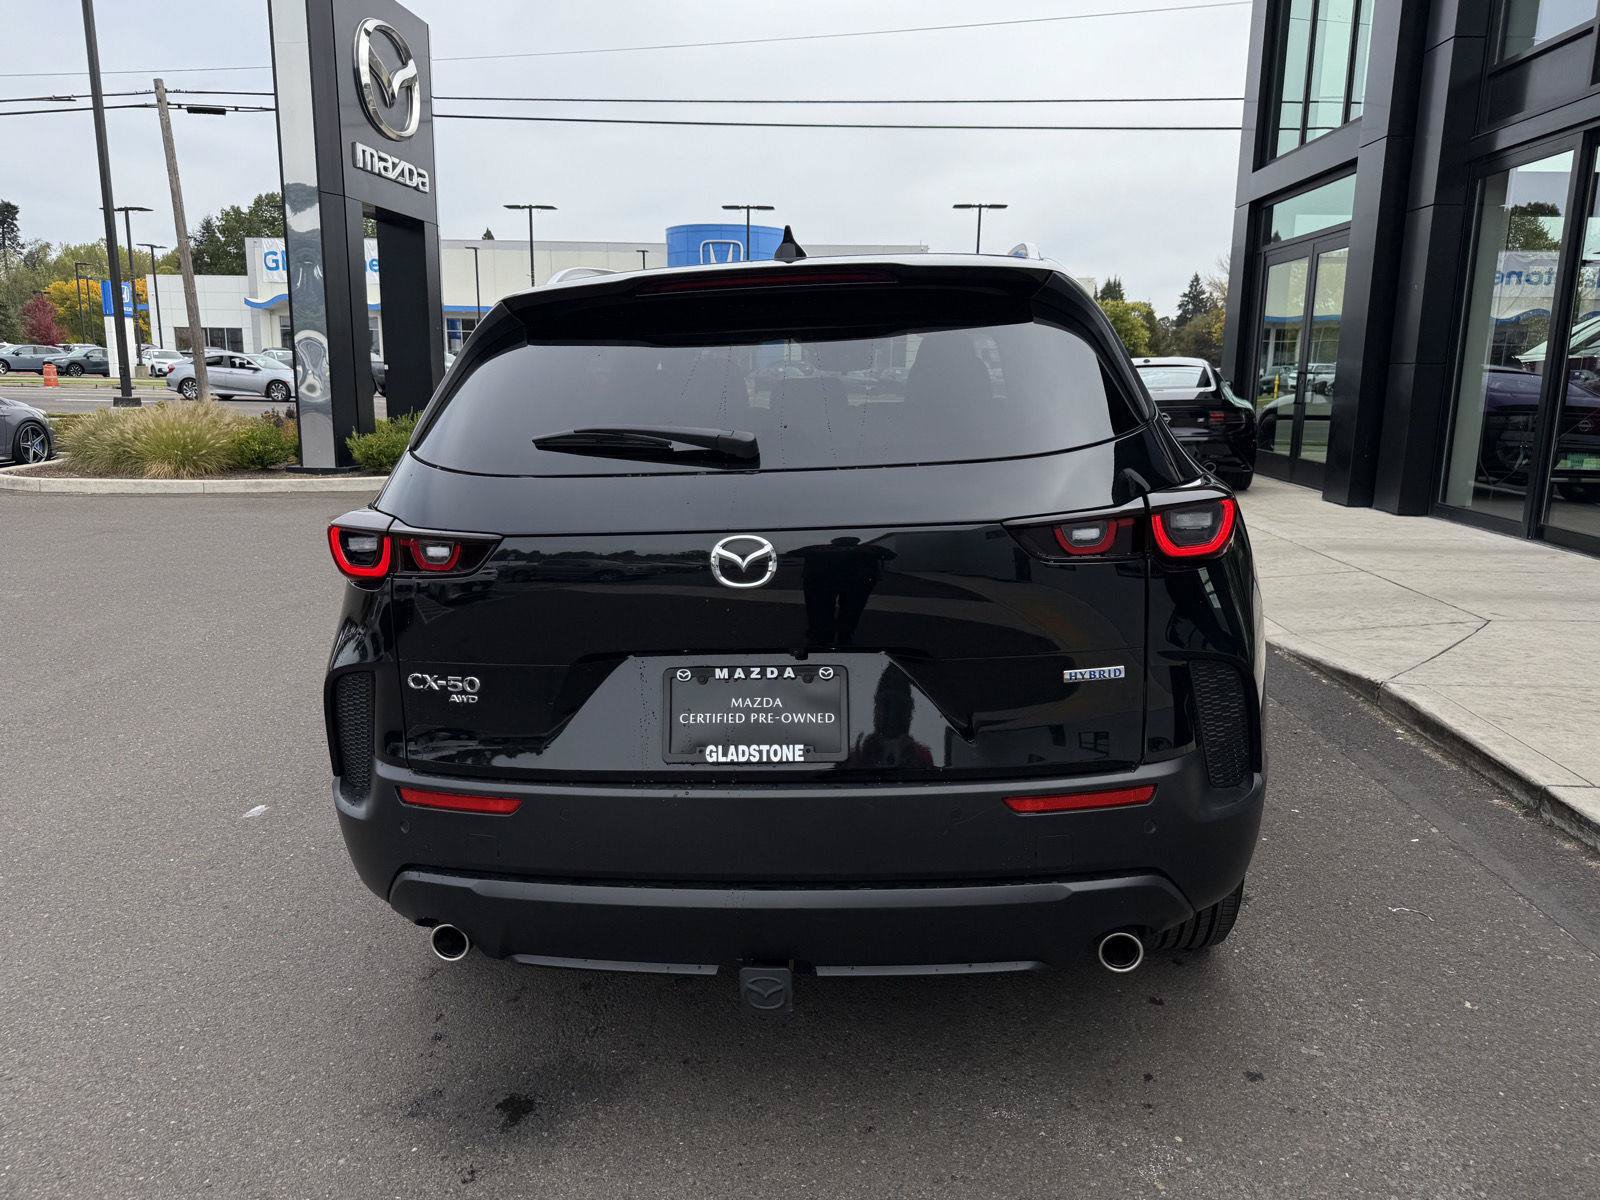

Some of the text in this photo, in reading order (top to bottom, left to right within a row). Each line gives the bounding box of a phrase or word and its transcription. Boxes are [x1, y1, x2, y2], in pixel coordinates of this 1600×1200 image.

[715, 667, 796, 680] MAZDA
[1068, 667, 1122, 681] HYBRID
[407, 673, 481, 693] CX-50
[449, 694, 479, 704] AWD
[730, 697, 783, 709] MAZDA
[679, 712, 835, 725] CERTIFIED PRE-OWNED
[705, 744, 805, 763] GLADSTONE
